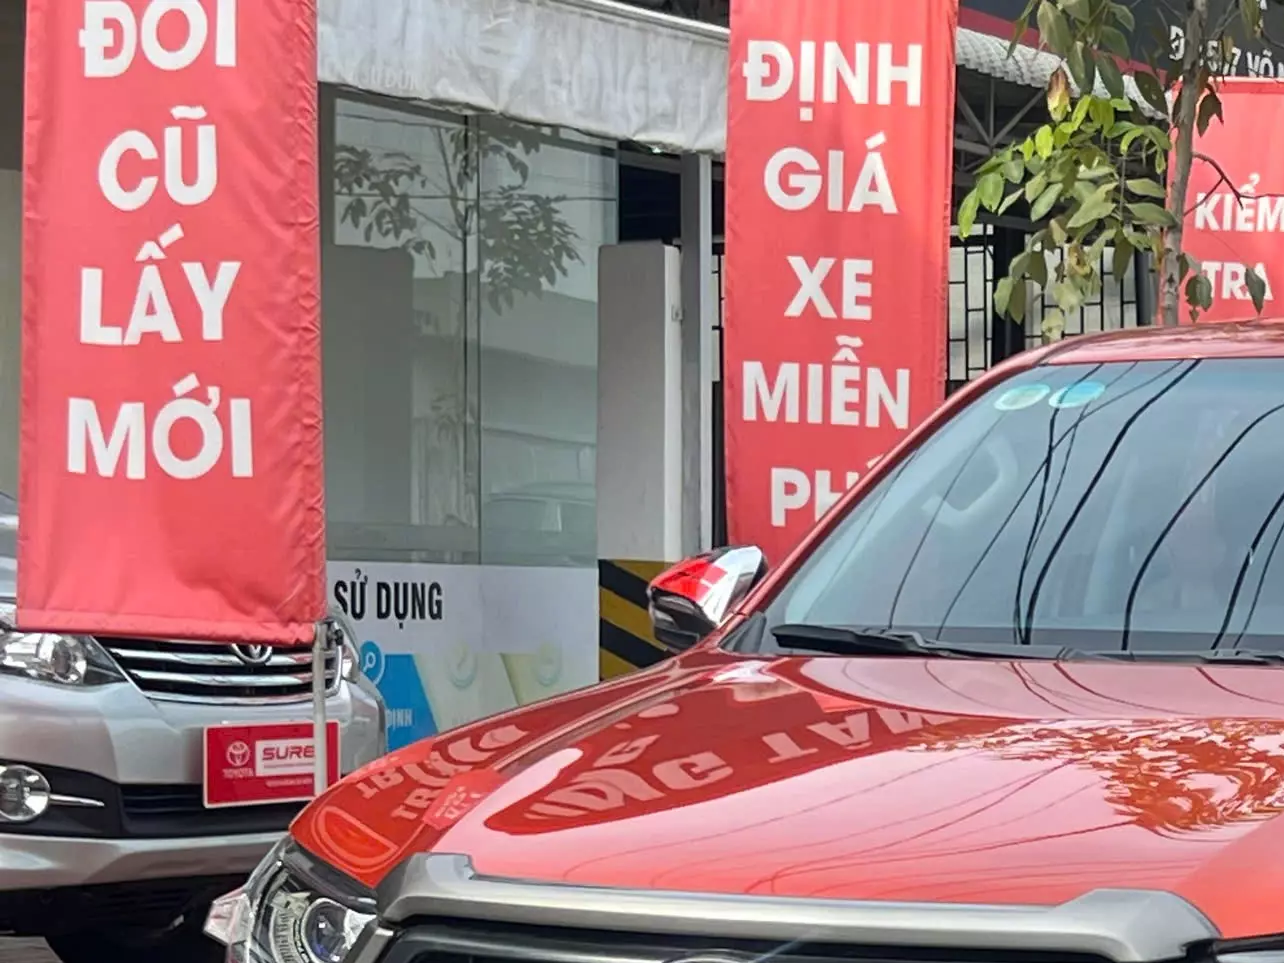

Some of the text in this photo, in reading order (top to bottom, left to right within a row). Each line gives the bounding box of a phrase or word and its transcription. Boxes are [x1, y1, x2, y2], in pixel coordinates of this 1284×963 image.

[742, 40, 922, 121] ĐỊNH
[99, 105, 218, 211] CŨ
[764, 133, 897, 214] GIÁ
[80, 224, 241, 346] LẤY
[784, 256, 873, 321] XE
[1201, 260, 1274, 301] TRA
[742, 335, 911, 429] MIỄN
[67, 373, 253, 480] MỚI
[334, 568, 444, 629] SỬ DỤNG
